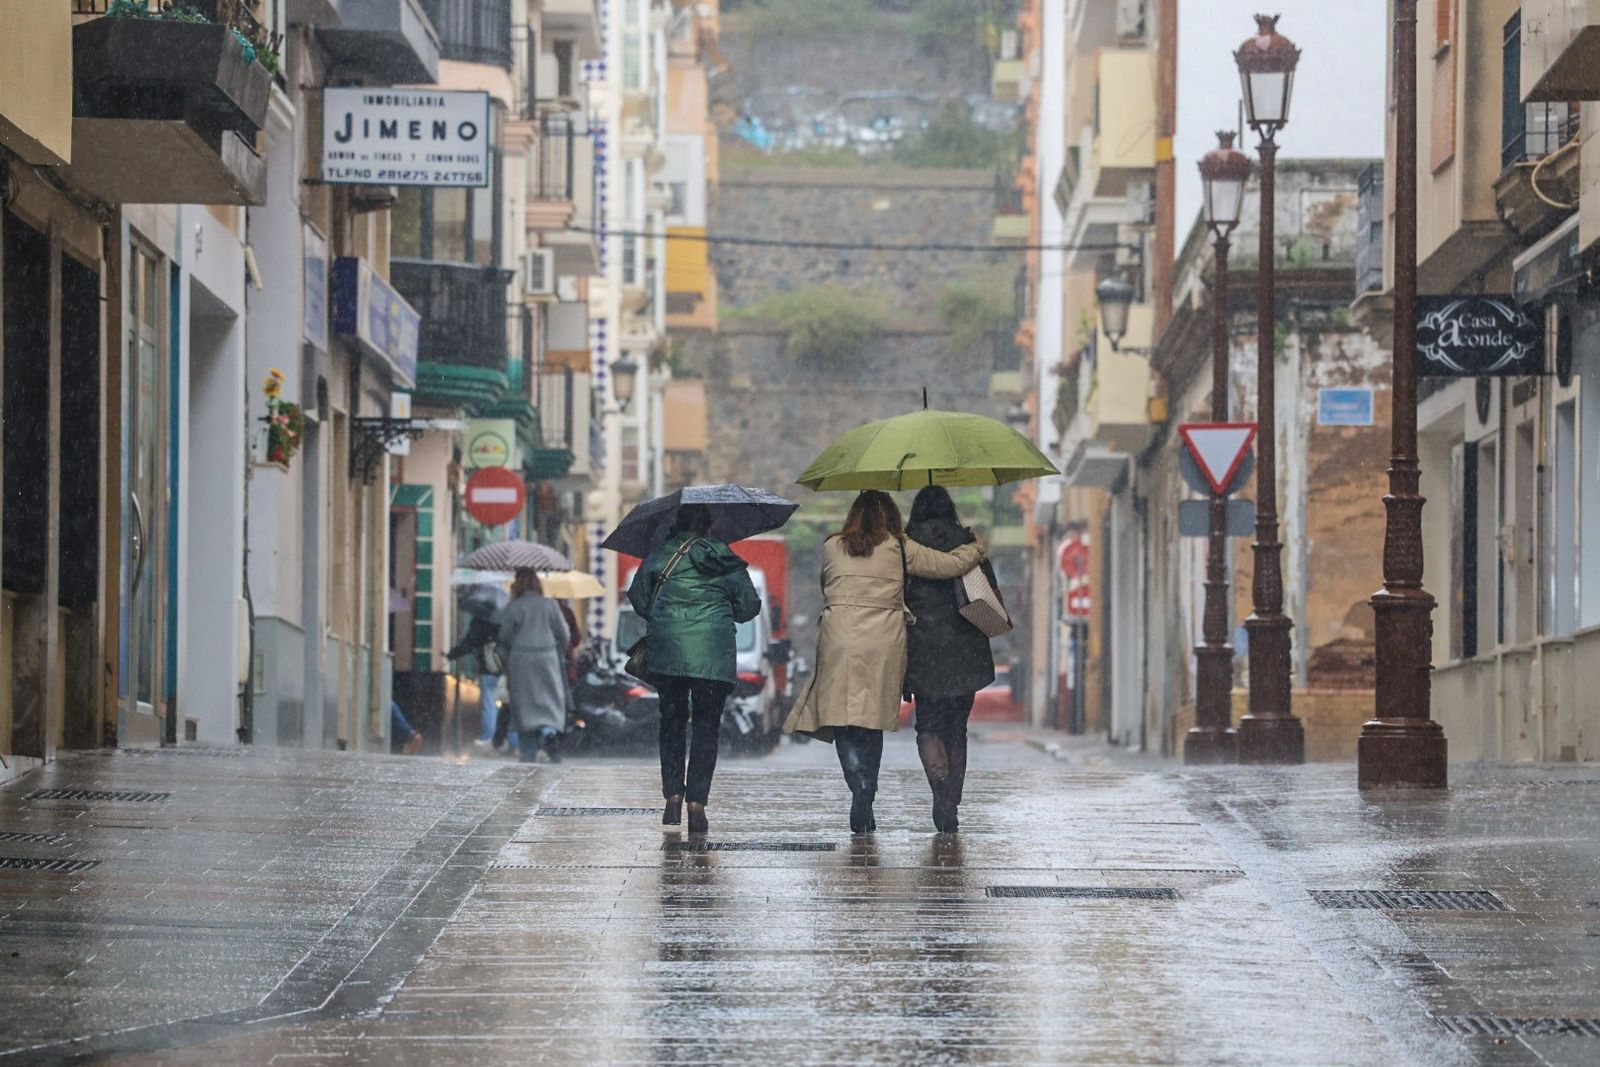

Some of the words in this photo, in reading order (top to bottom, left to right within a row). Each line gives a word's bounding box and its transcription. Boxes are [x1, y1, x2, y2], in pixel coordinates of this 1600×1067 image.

[363, 95, 446, 107] INMOBILIARIA
[334, 112, 478, 143] JIMENO
[1459, 313, 1496, 328] Casa
